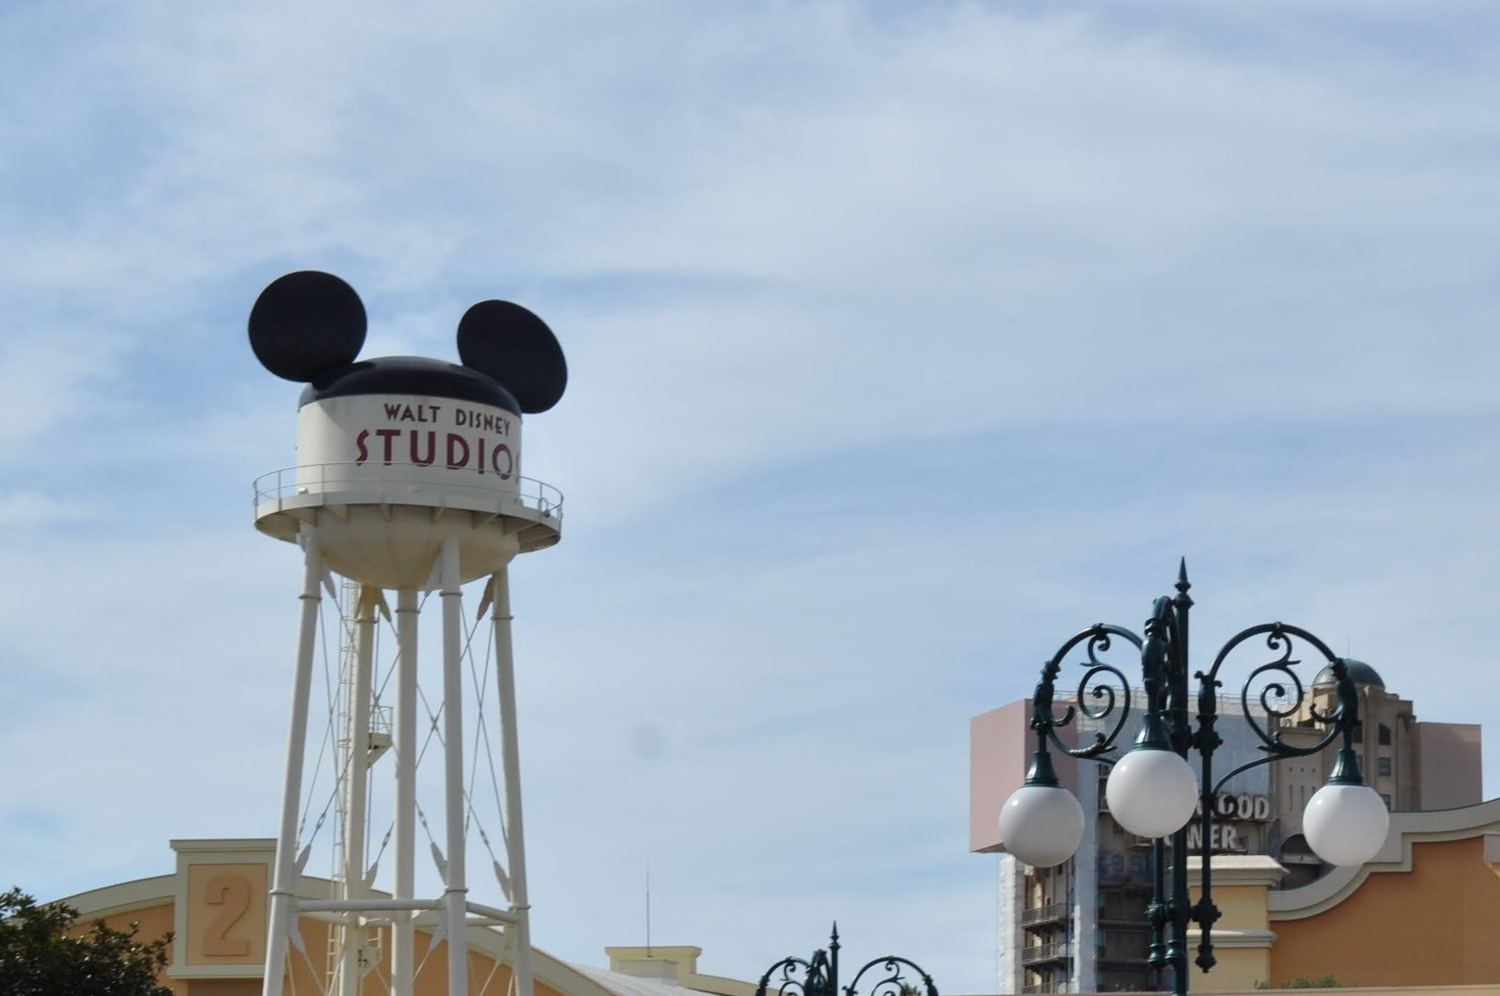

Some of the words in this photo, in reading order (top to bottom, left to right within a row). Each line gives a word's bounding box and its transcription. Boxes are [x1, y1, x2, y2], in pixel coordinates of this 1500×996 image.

[384, 403, 441, 423] WALT
[455, 408, 511, 437] DISNEY
[356, 429, 520, 485] STUDIO
[203, 872, 252, 957] 2
